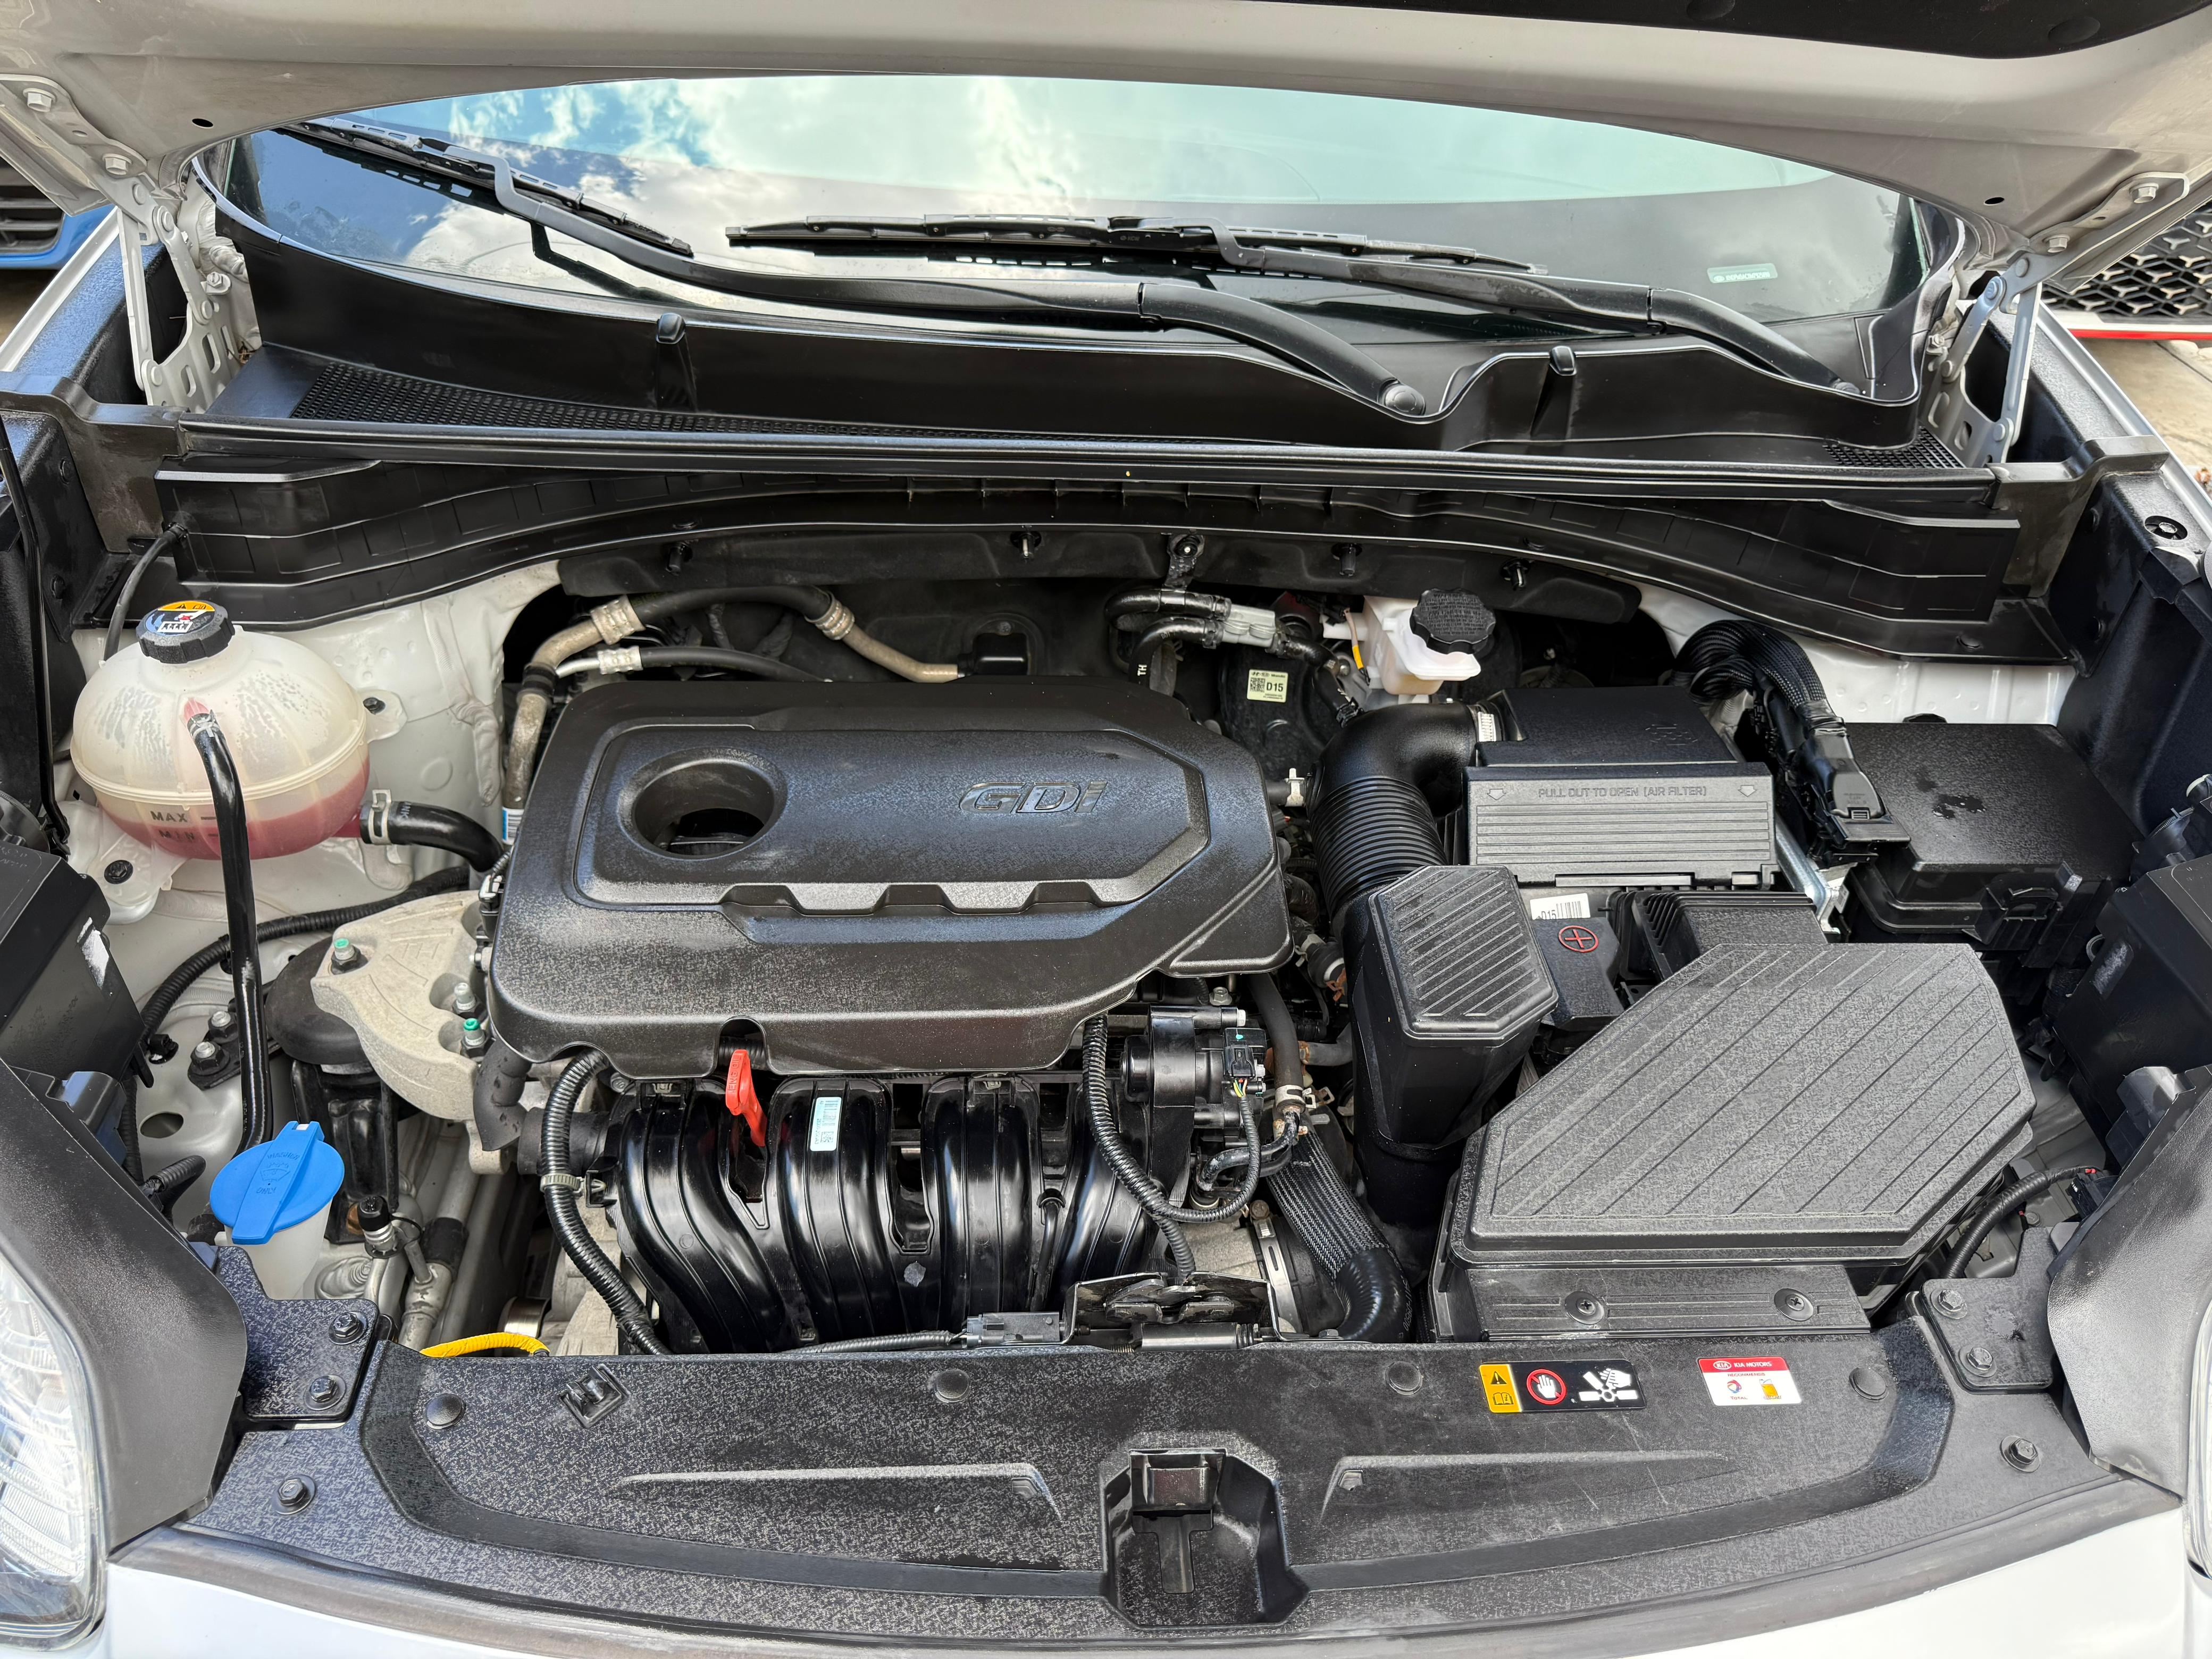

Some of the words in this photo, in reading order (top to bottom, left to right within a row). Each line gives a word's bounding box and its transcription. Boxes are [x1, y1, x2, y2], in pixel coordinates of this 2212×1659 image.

[1266, 682, 1284, 692] D15
[1538, 788, 1565, 798] PULL
[1569, 787, 1590, 797] OUT
[1593, 787, 1606, 797] TO
[1610, 787, 1639, 797] OPEN
[150, 810, 188, 823] MAX
[158, 830, 195, 842] MIN
[732, 1055, 742, 1068] OIL
[728, 1071, 738, 1093] ENG
[267, 1152, 300, 1160] WASHER
